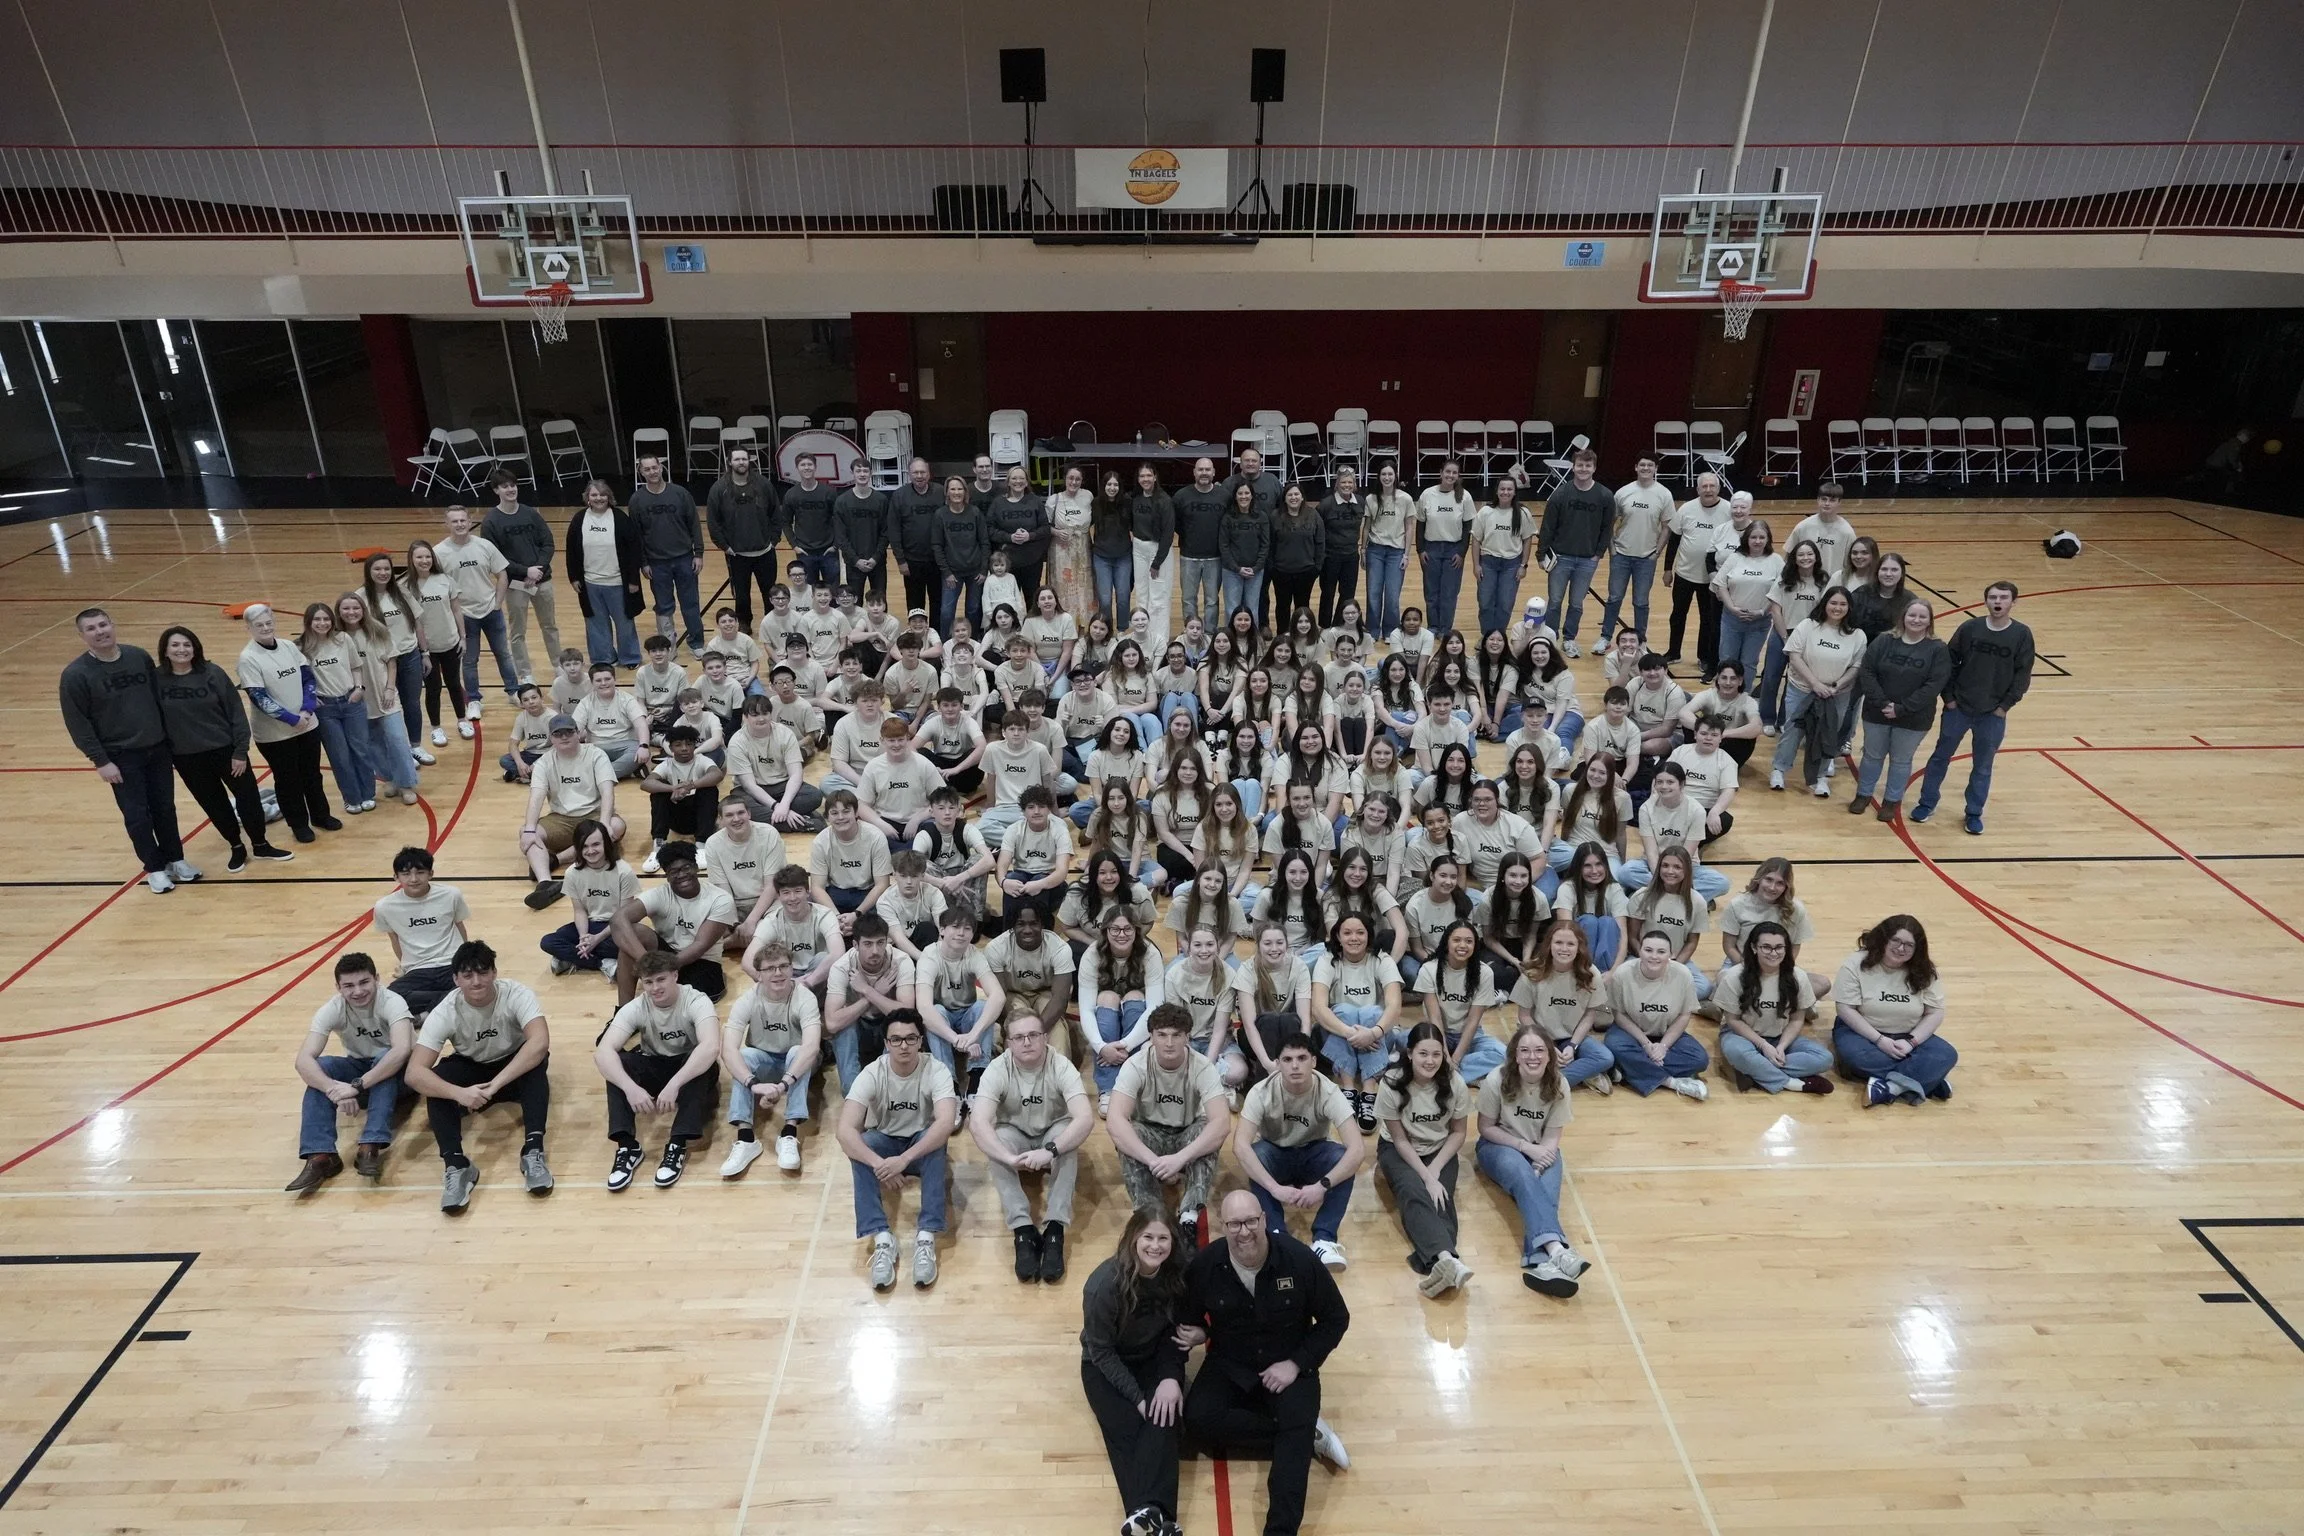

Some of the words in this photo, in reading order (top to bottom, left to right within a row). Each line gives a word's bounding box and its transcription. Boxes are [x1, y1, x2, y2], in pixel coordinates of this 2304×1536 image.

[1143, 169, 1177, 178] BAGELS
[1436, 505, 1454, 513] Jesus
[1567, 502, 1596, 512] HERO
[1631, 501, 1649, 509] Jesus
[1002, 510, 1032, 520] HERO
[1816, 537, 1835, 546] Jesus
[459, 560, 478, 568] Jesus
[421, 594, 442, 603] Jesus
[1795, 593, 1815, 601] Jesus
[1818, 639, 1840, 650] Jesus
[1971, 641, 2012, 658] HERO
[315, 657, 338, 667] Jesus
[1885, 654, 1925, 669] HERO
[277, 667, 297, 679] Jesus
[104, 672, 147, 693] HERO
[1215, 675, 1231, 684] Jesus
[651, 685, 669, 693] Jesus
[708, 696, 725, 705] Jesus
[1639, 704, 1656, 713] Jesus
[596, 717, 617, 725] Jesus
[527, 732, 547, 740] Jesus
[859, 740, 880, 748] Jesus
[1005, 764, 1026, 773] Jesus
[1685, 769, 1706, 780] Jesus
[561, 776, 581, 784] Jesus
[889, 781, 909, 789] Jesus
[1176, 815, 1200, 823] Jesus
[1660, 828, 1680, 837] Jesus
[1478, 843, 1502, 853] Jesus
[1025, 849, 1047, 859] Jesus
[732, 860, 756, 871] Jesus
[840, 858, 862, 868] Jesus
[586, 888, 610, 898] Jesus
[408, 916, 437, 928] Jesus
[1657, 914, 1685, 927] Jesus
[791, 942, 812, 951] Jesus
[1016, 970, 1041, 980] Jesus
[1344, 986, 1371, 996] Jesus
[1190, 995, 1215, 1006] Jesus
[1442, 992, 1468, 1003] Jesus
[1549, 997, 1577, 1007] Jesus
[1879, 992, 1910, 1003] Jesus
[1640, 1002, 1669, 1013] Jesus
[764, 1020, 788, 1032] Jesus
[660, 1030, 686, 1040] Jesus
[1158, 1094, 1184, 1105] Jesus
[888, 1100, 918, 1111] Jesus
[1412, 1112, 1442, 1123] Jesus
[1514, 1106, 1545, 1120] Jesus
[1284, 1113, 1310, 1127] Jesus
